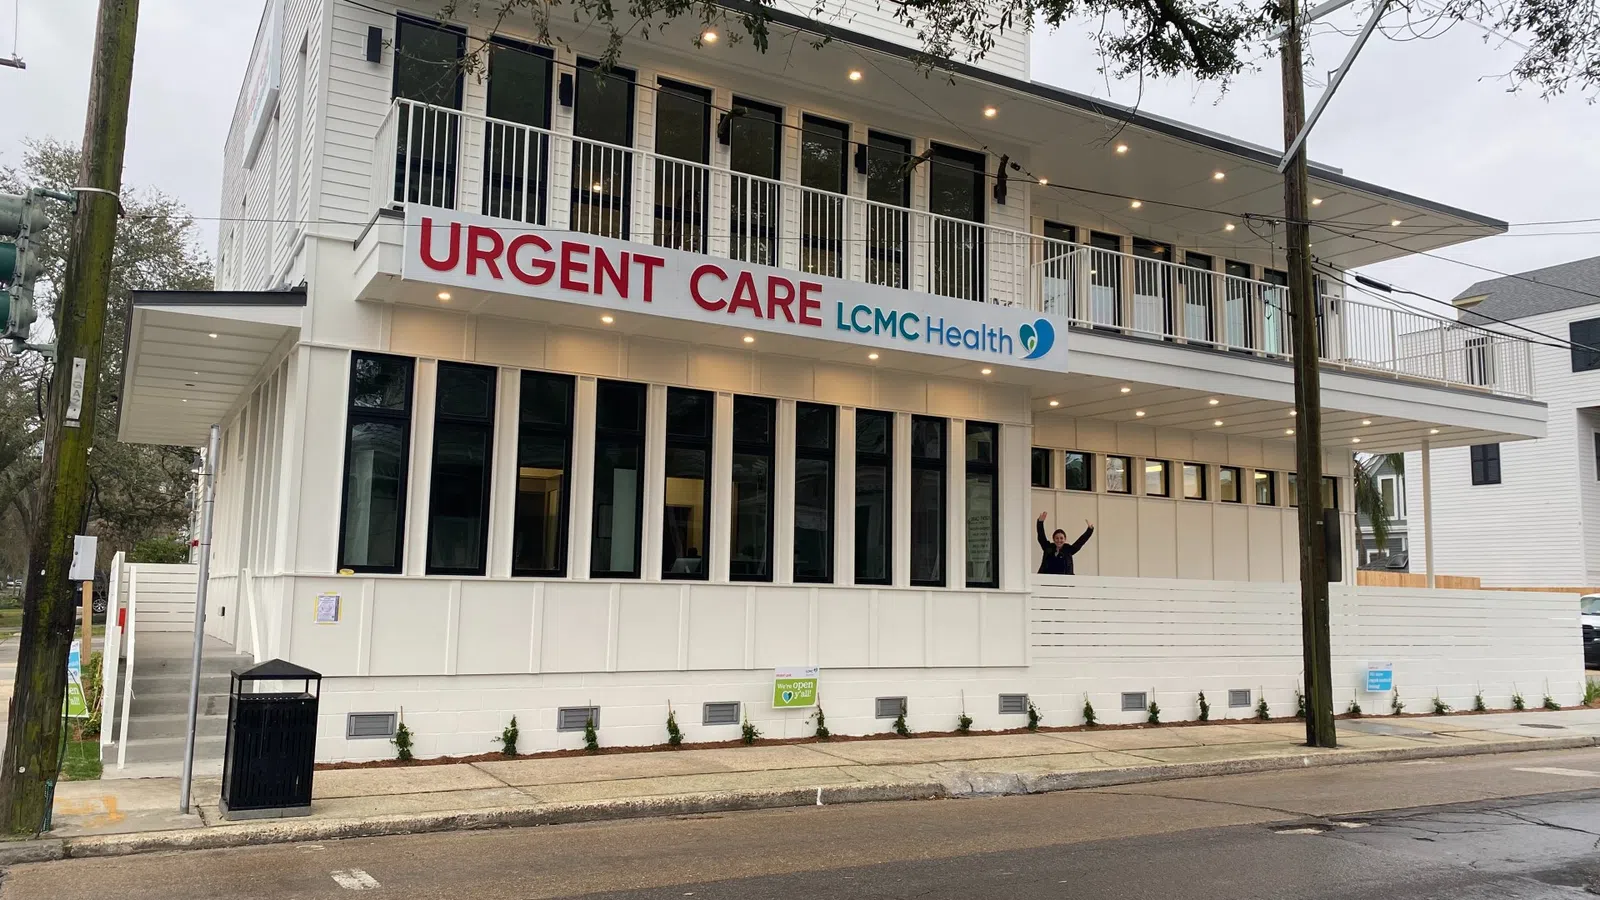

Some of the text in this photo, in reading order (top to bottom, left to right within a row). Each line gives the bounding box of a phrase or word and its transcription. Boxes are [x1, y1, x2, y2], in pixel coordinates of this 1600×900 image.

[419, 216, 1013, 355] URGENT CARE LCMC Health
[793, 682, 813, 690] open
[794, 690, 812, 699] y'all!
